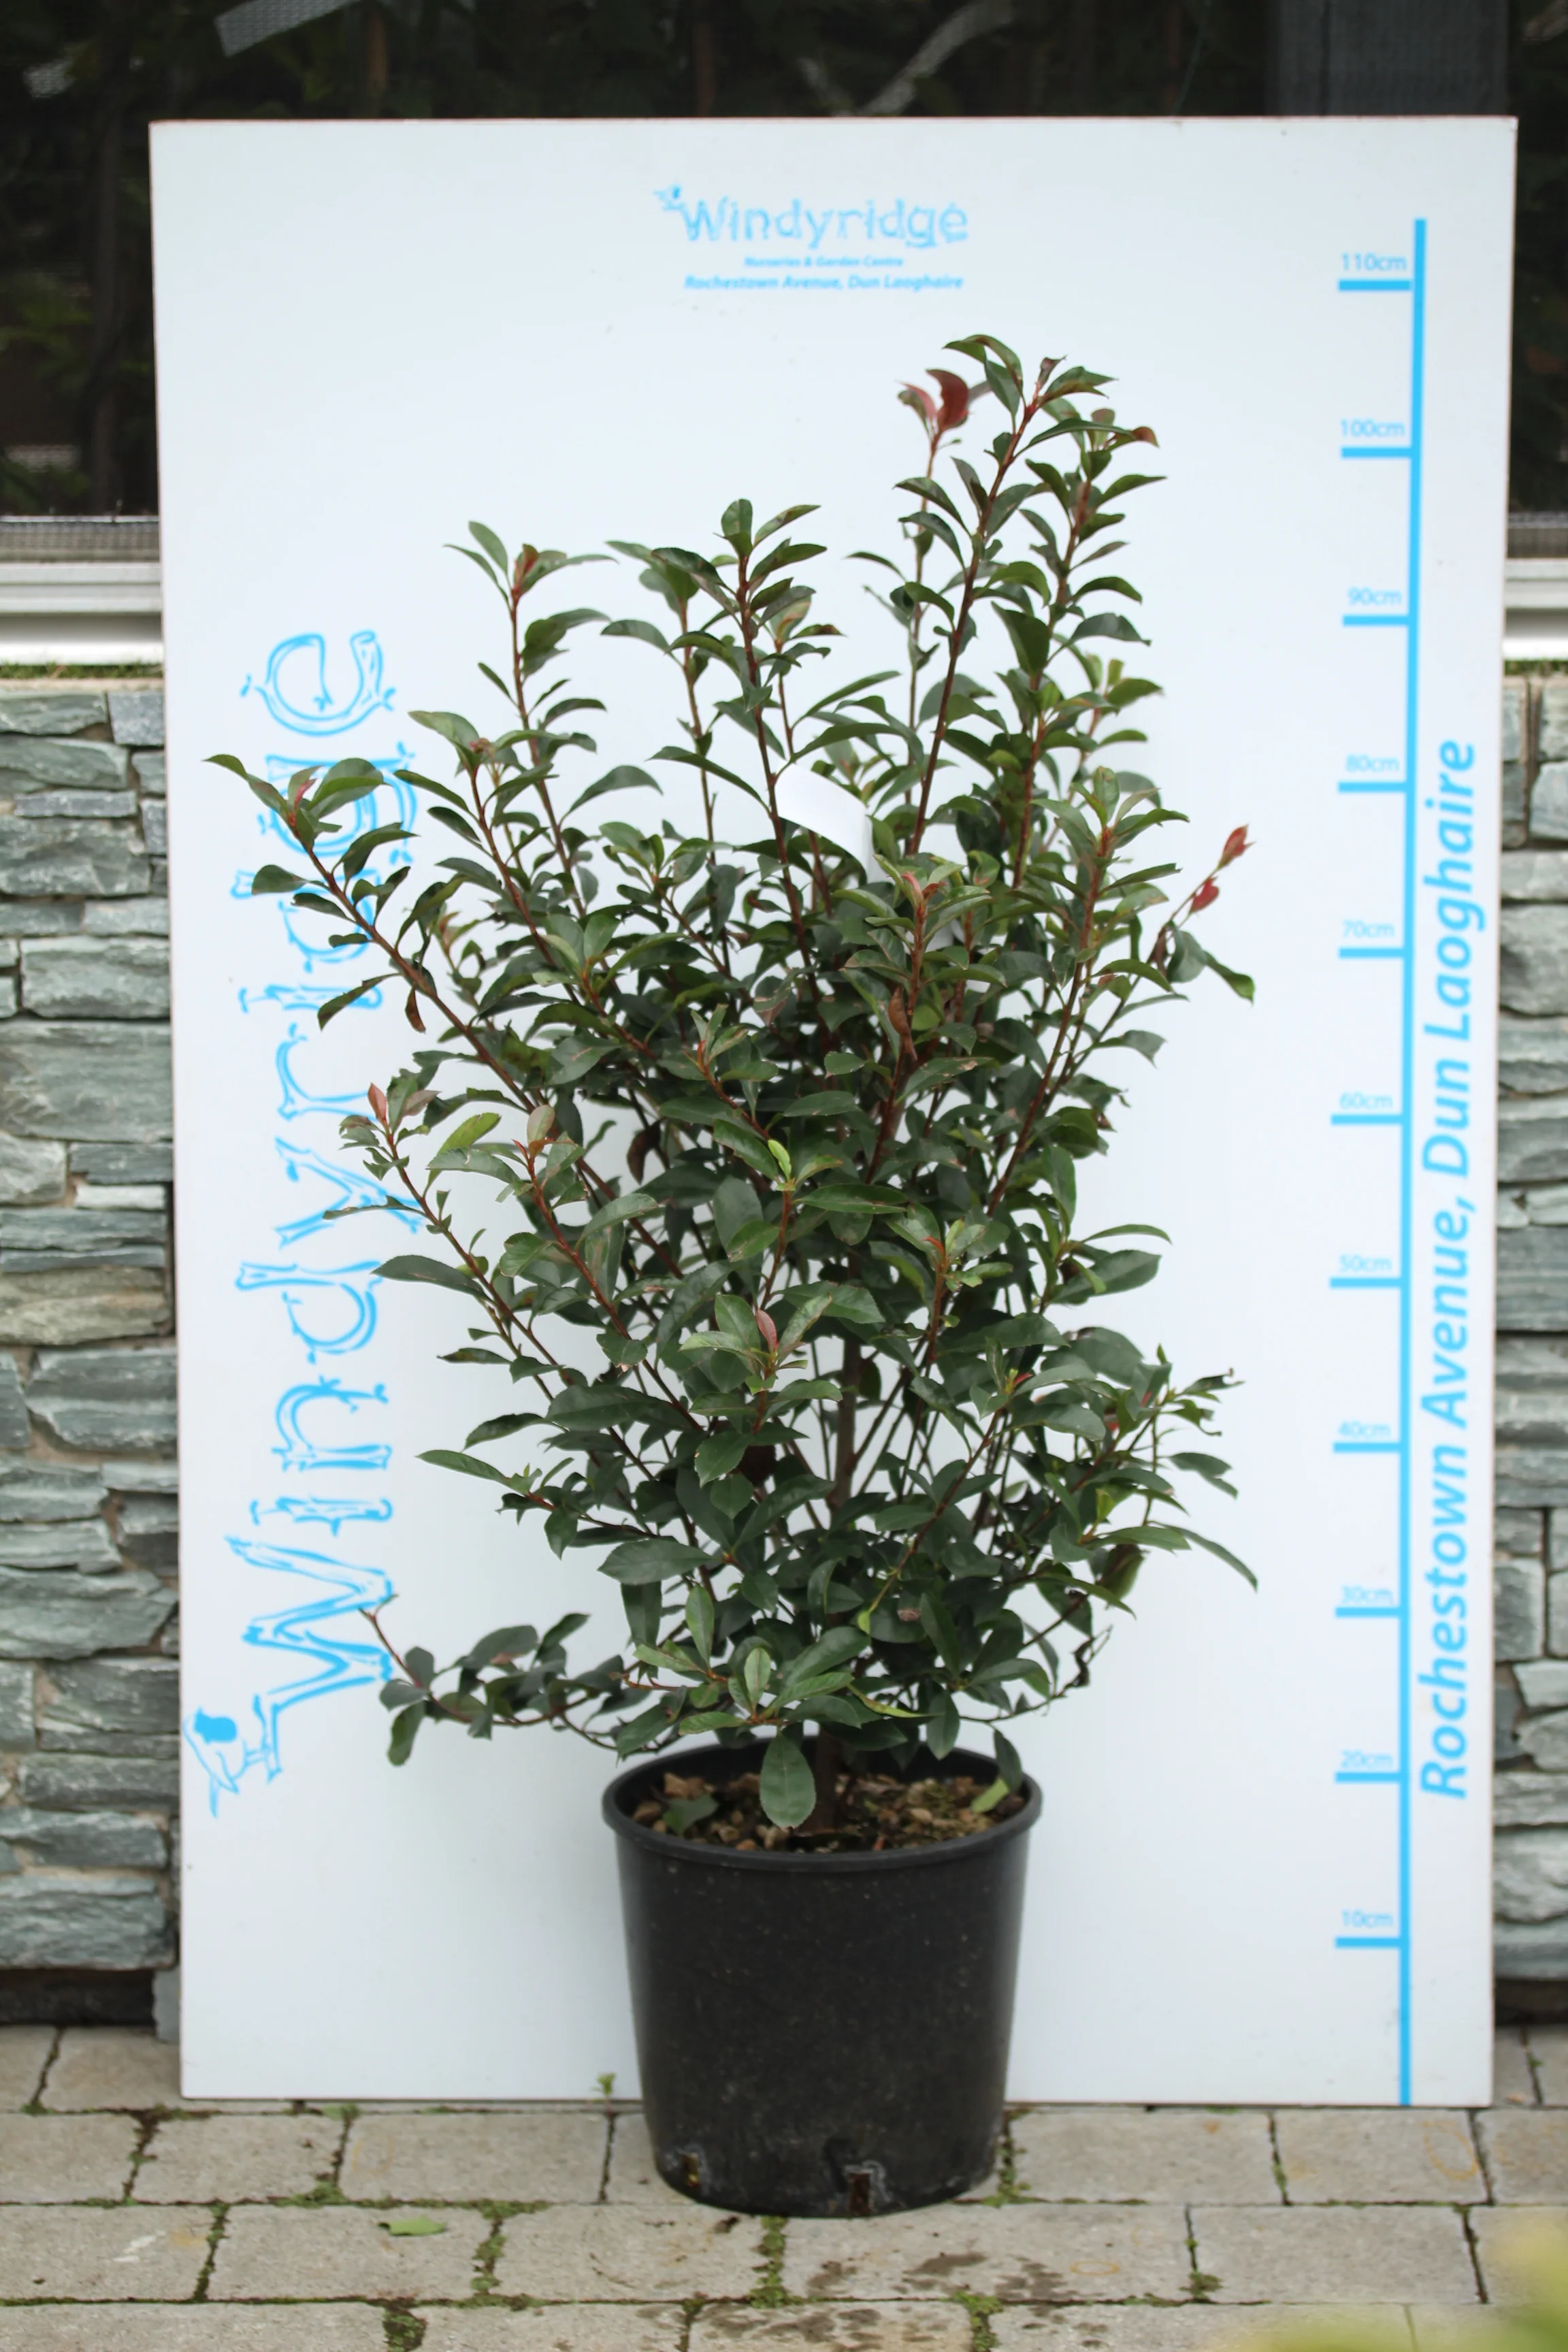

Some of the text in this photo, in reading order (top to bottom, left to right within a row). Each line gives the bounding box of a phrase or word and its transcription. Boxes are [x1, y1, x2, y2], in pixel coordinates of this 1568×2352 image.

[681, 196, 969, 250] Windyridge
[815, 255, 862, 268] Garden
[864, 255, 905, 268] Centre
[1341, 250, 1407, 272] 110cm
[682, 274, 965, 293] Rochestown Avenue, Dun Laoghaire
[1339, 416, 1406, 438] 100cm
[1348, 585, 1403, 606] 90cm
[1345, 753, 1400, 773] 80cm
[1341, 919, 1395, 939] 70cm
[1339, 1090, 1393, 1111] 60cm
[1338, 1253, 1392, 1273] 50cm
[1417, 736, 1489, 1801] Rochestown Avenue, Dun Laoghaire
[1337, 1419, 1391, 1439] 40cm
[1339, 1584, 1394, 1603] 30cm
[1339, 1748, 1394, 1769] 20cm
[1341, 1908, 1394, 1929] 10cm
